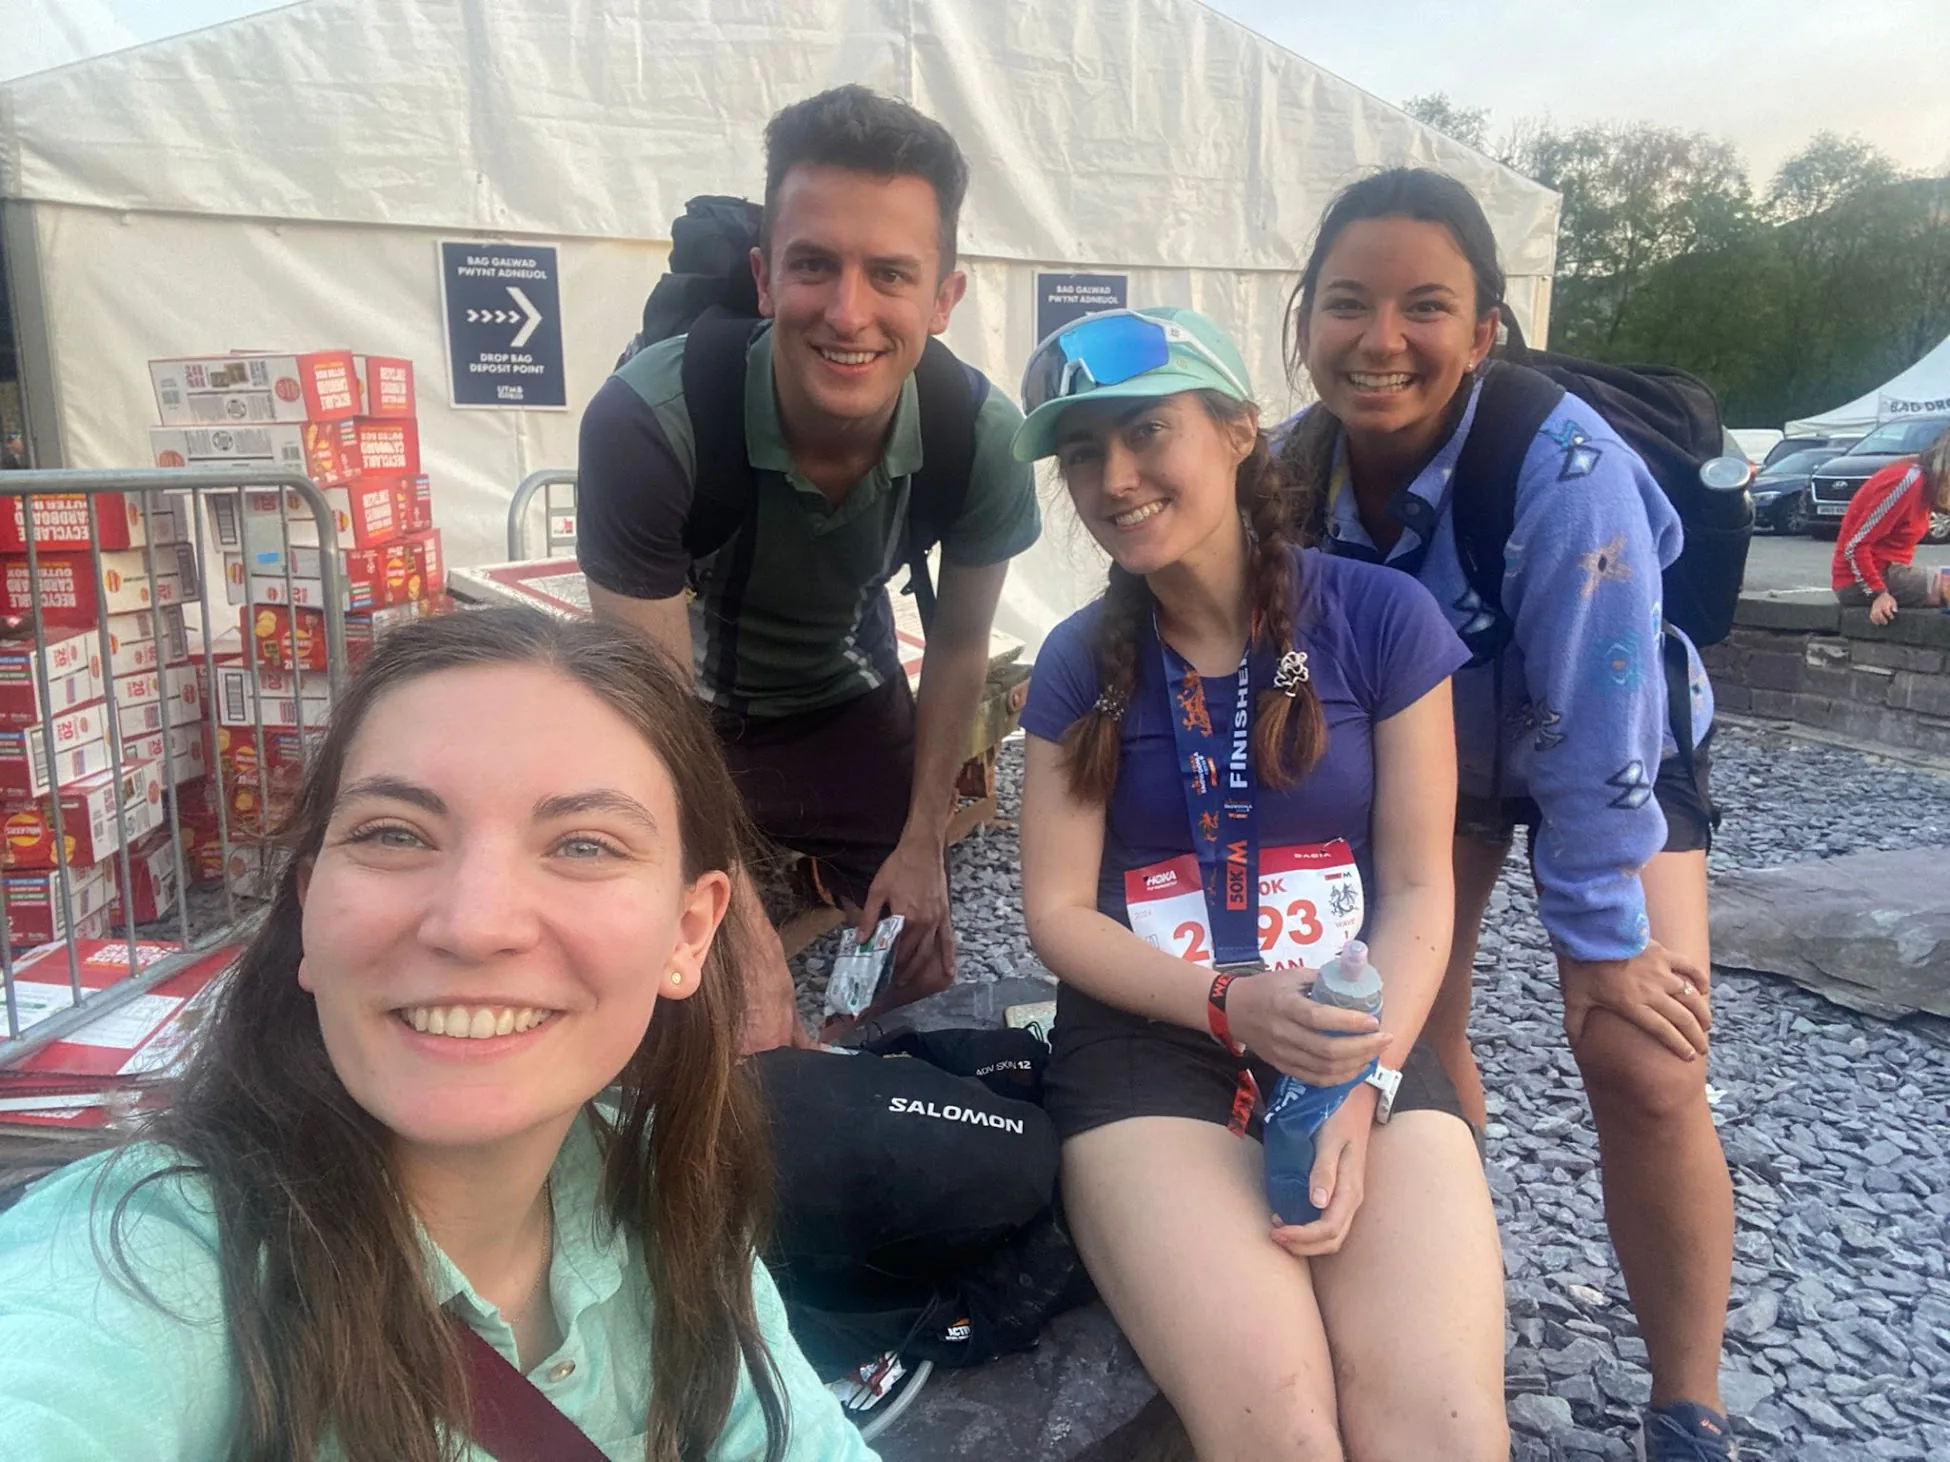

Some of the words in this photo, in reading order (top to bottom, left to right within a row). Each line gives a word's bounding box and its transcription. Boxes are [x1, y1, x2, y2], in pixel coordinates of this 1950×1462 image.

[467, 256, 489, 266] BAG
[492, 257, 536, 268] GALWAD
[458, 267, 495, 277] PWYNT
[498, 268, 547, 279] ADNEUOL
[1056, 285, 1074, 293] BAG
[480, 353, 509, 362] DROP
[511, 354, 532, 363] BAG
[469, 364, 510, 373] DEPOSIT
[512, 365, 544, 374] POINT
[14, 511, 89, 525] ARDBOAD
[18, 526, 90, 542] ECYCLABE
[6, 578, 74, 592] CARDBARD
[1146, 870, 1177, 886] HOKA
[1258, 878, 1287, 896] 0K
[976, 1064, 994, 1076] ADV
[996, 1061, 1016, 1070] SKIN
[1018, 1060, 1032, 1070] 12
[888, 1097, 1024, 1135] SALOMON
